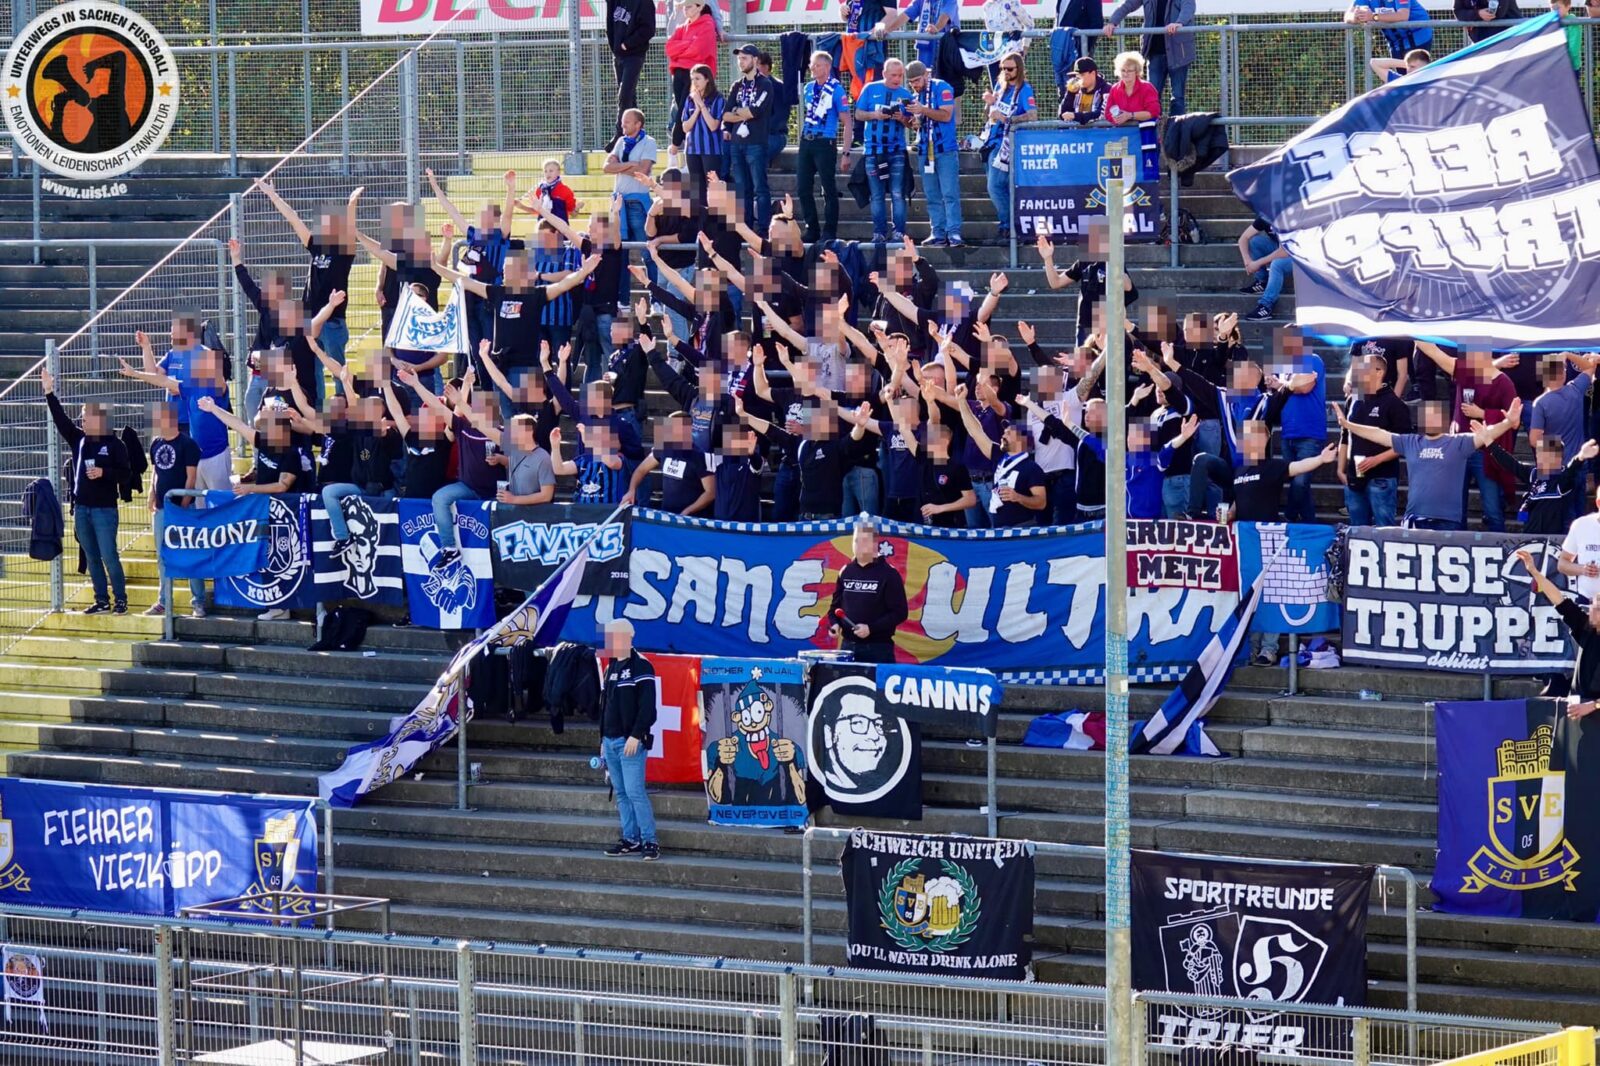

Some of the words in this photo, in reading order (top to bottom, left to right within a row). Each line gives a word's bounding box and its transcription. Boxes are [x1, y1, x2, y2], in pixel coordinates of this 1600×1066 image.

[1020, 142, 1094, 156] EINTRACHT
[1021, 158, 1058, 170] TRIER
[1019, 199, 1075, 210] FANCLUB
[1019, 213, 1154, 234] FELLAL
[164, 519, 258, 550] CHAONZ
[1138, 553, 1222, 589] METZ
[1347, 538, 1505, 595] REISE
[247, 585, 283, 601] KONZ
[1347, 597, 1565, 654] TRUPPE
[1426, 651, 1490, 670] delikat
[884, 674, 993, 716] CANNIS
[1496, 792, 1562, 824] SVE
[43, 805, 154, 846] FIEHRER
[851, 830, 944, 859] SCHWEICH
[1521, 834, 1534, 849] 05
[1486, 861, 1553, 883] TRIE
[1164, 876, 1334, 911] SPORTFREUNDE
[848, 943, 886, 962] OU'LL
[889, 950, 929, 967] NEVER
[931, 953, 972, 969] DRINK
[973, 953, 1018, 969] ALONE
